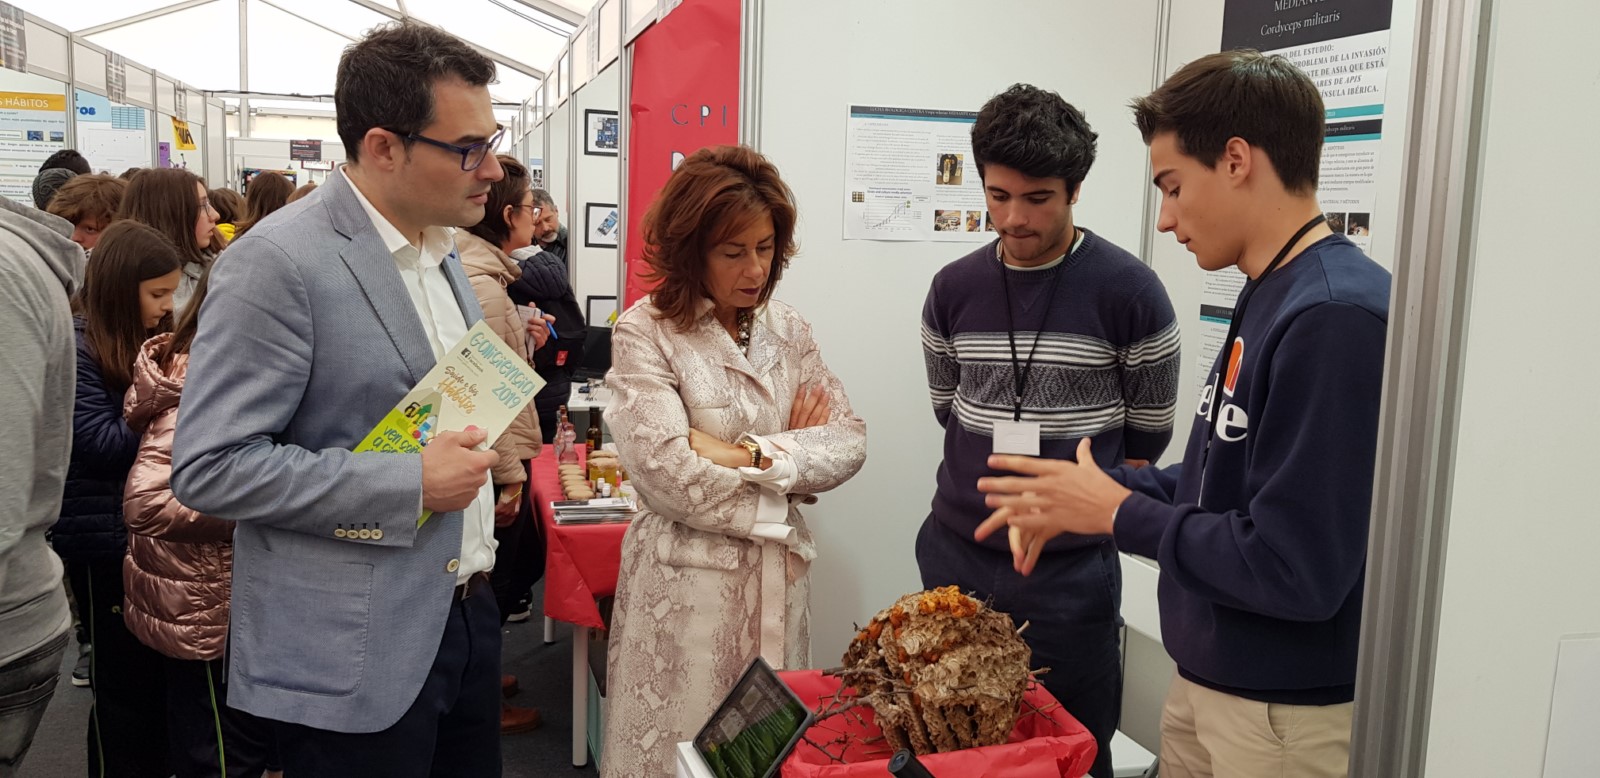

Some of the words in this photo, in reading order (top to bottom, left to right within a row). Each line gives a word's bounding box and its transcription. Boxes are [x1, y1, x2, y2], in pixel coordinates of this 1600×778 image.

[1260, 20, 1302, 37] Cordyceps
[1303, 10, 1341, 28] militaris
[1289, 50, 1301, 58] DEL
[1303, 44, 1335, 56] ESTUDIO:
[1329, 54, 1339, 63] DE
[1341, 52, 1351, 61] LA
[1351, 46, 1387, 60] INVASIÓN
[1320, 68, 1330, 76] DE
[1331, 65, 1347, 75] ASIA
[1349, 61, 1364, 72] QUE
[1365, 58, 1385, 69] ESTÁ
[1316, 78, 1332, 87] ARES
[1333, 77, 1343, 85] DE
[1344, 75, 1363, 84] APIS
[1321, 88, 1346, 98] ÍNSULA
[1347, 85, 1379, 95] IBÉRICA.
[5, 97, 49, 108] HÁBITOS
[491, 381, 522, 409] 2019
[383, 425, 403, 445] ven
